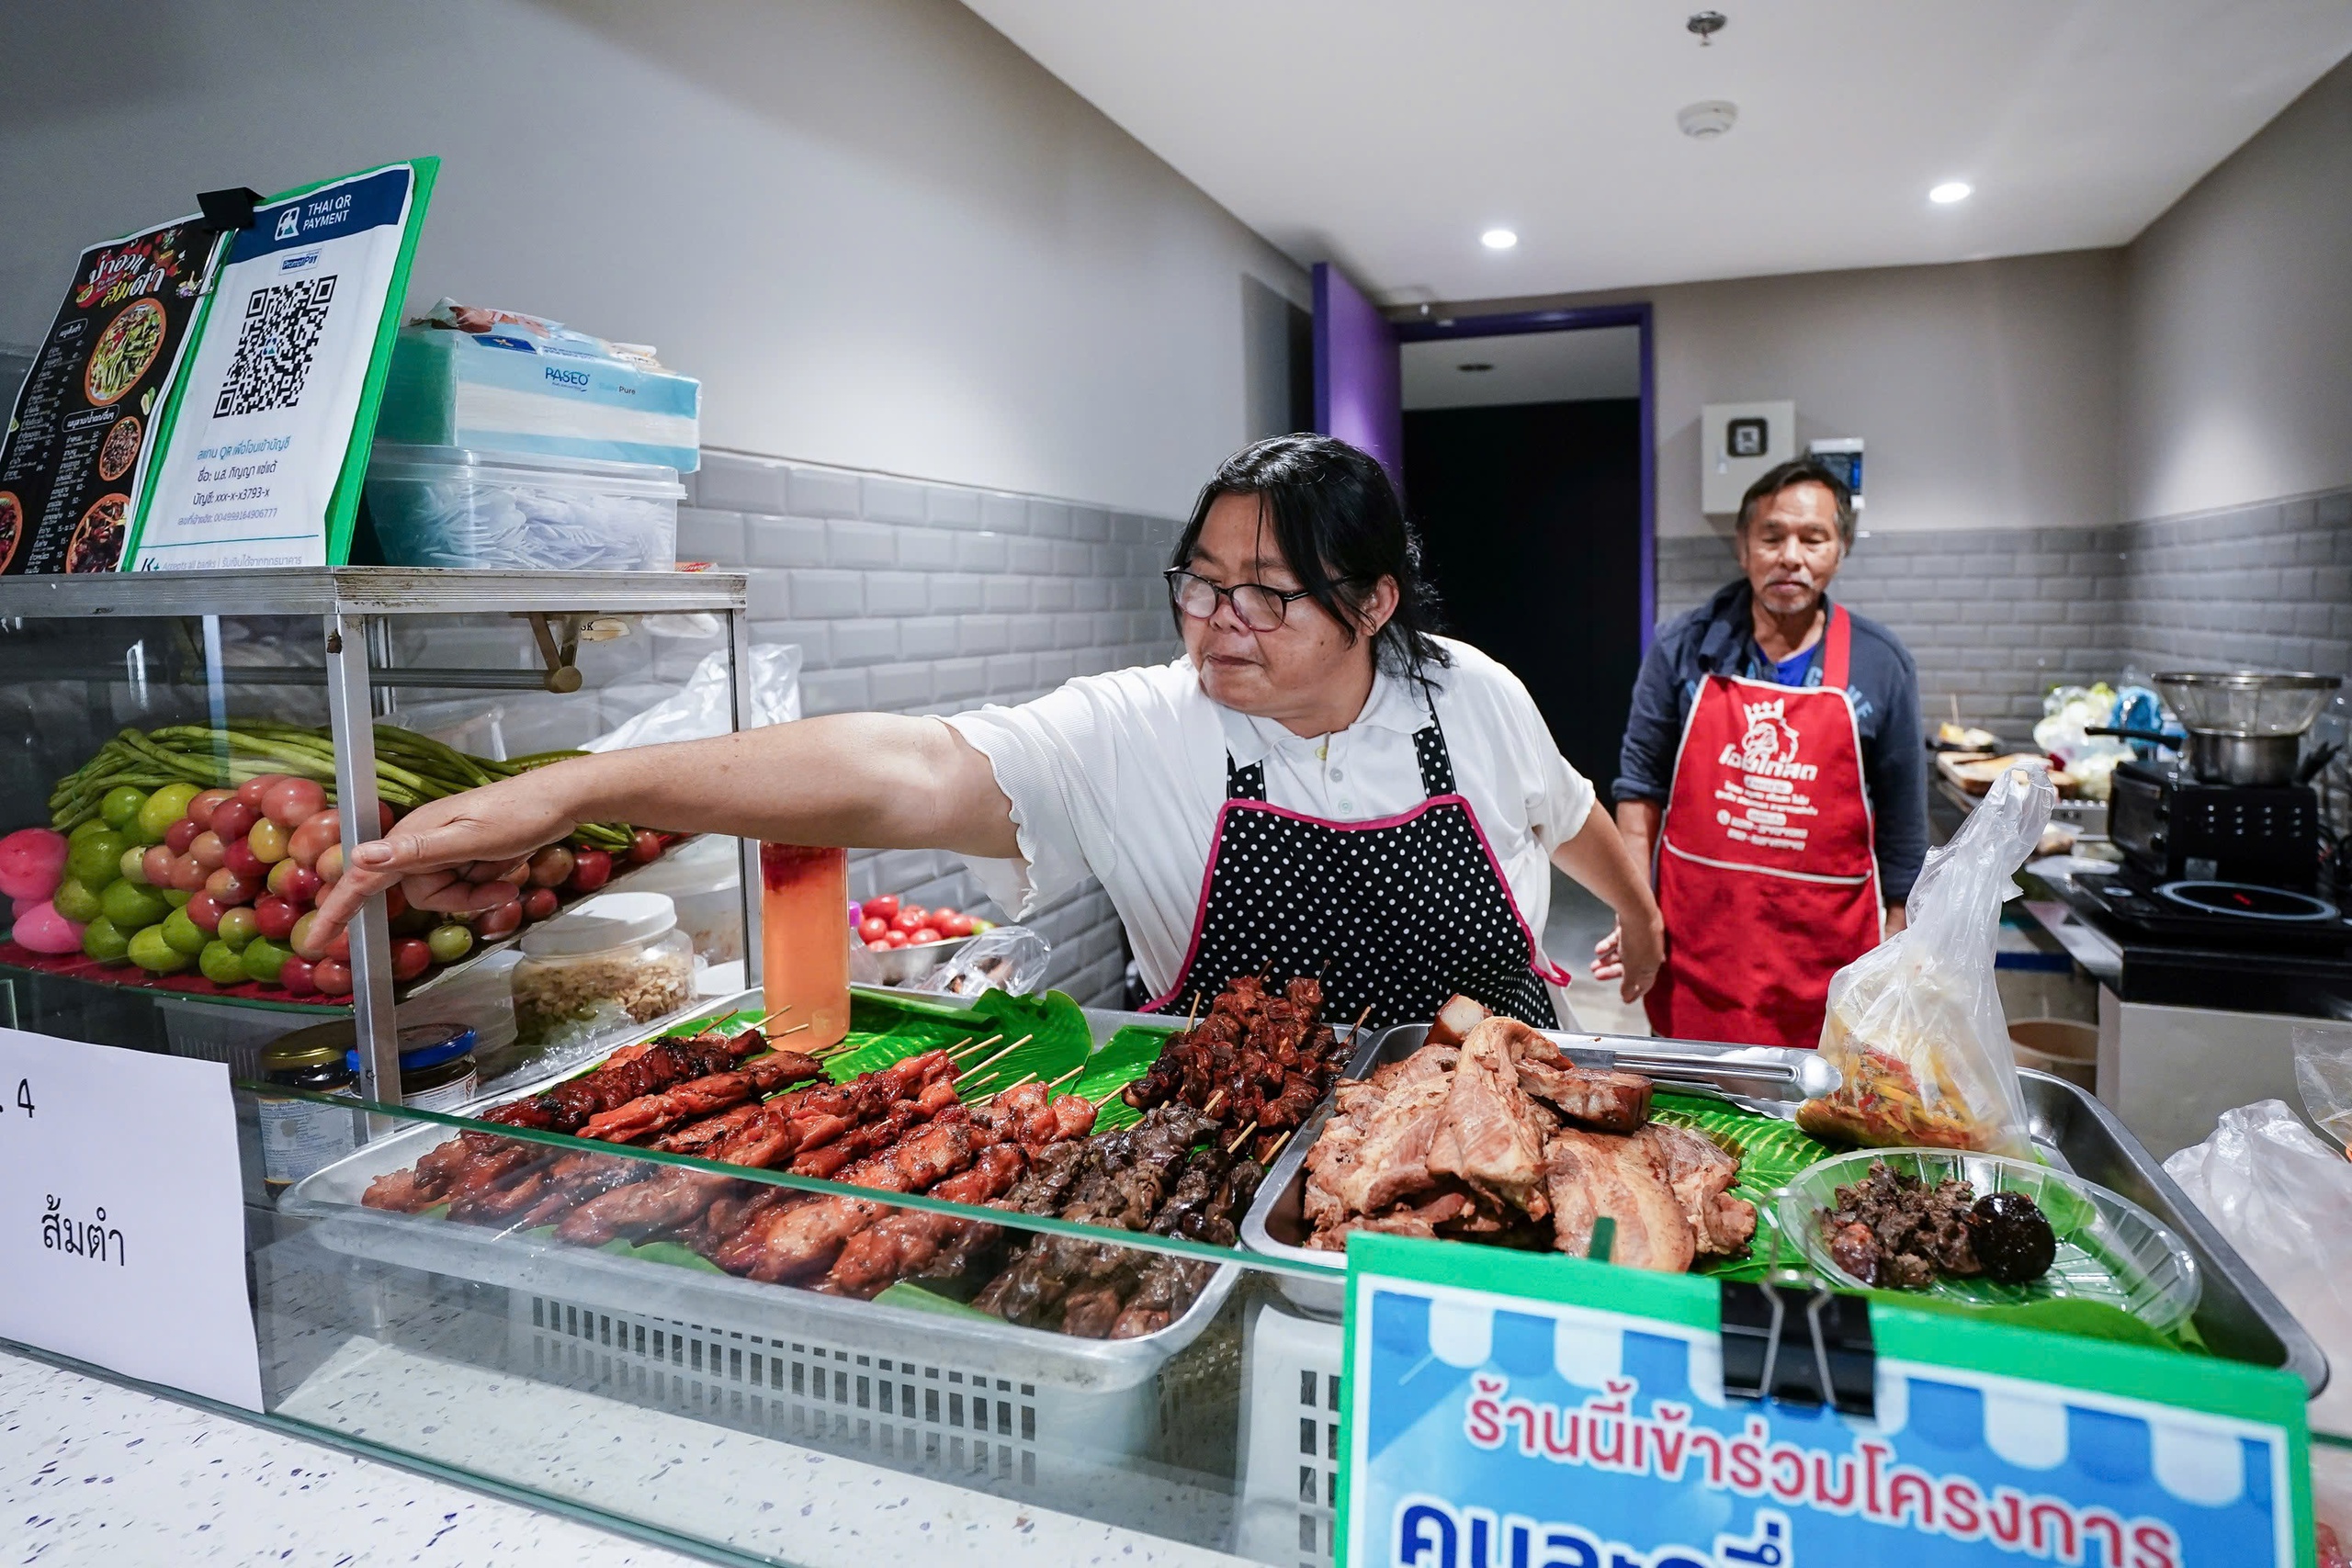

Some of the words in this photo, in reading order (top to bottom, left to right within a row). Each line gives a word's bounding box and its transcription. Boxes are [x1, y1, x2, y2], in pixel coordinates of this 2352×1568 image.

[308, 198, 334, 217] THAI
[334, 194, 352, 209] QR
[302, 209, 350, 231] PAYMENT
[101, 264, 165, 308] ส้มตำ
[545, 367, 589, 386] PASEO
[618, 385, 636, 395] Pure
[197, 448, 217, 460] สแกน
[219, 446, 232, 460] QR
[232, 435, 291, 457] เพื่อโอนเข้าบัญชี
[198, 467, 212, 482] ชื่อ:
[193, 491, 213, 507] บัญชี:
[214, 487, 270, 502] xxx-x-x3793-x
[17, 1077, 35, 1118] 4
[41, 1194, 125, 1267] ส้มตำ
[1469, 1379, 2175, 1568] ร้านนี้เข้าร่วมโครงการ
